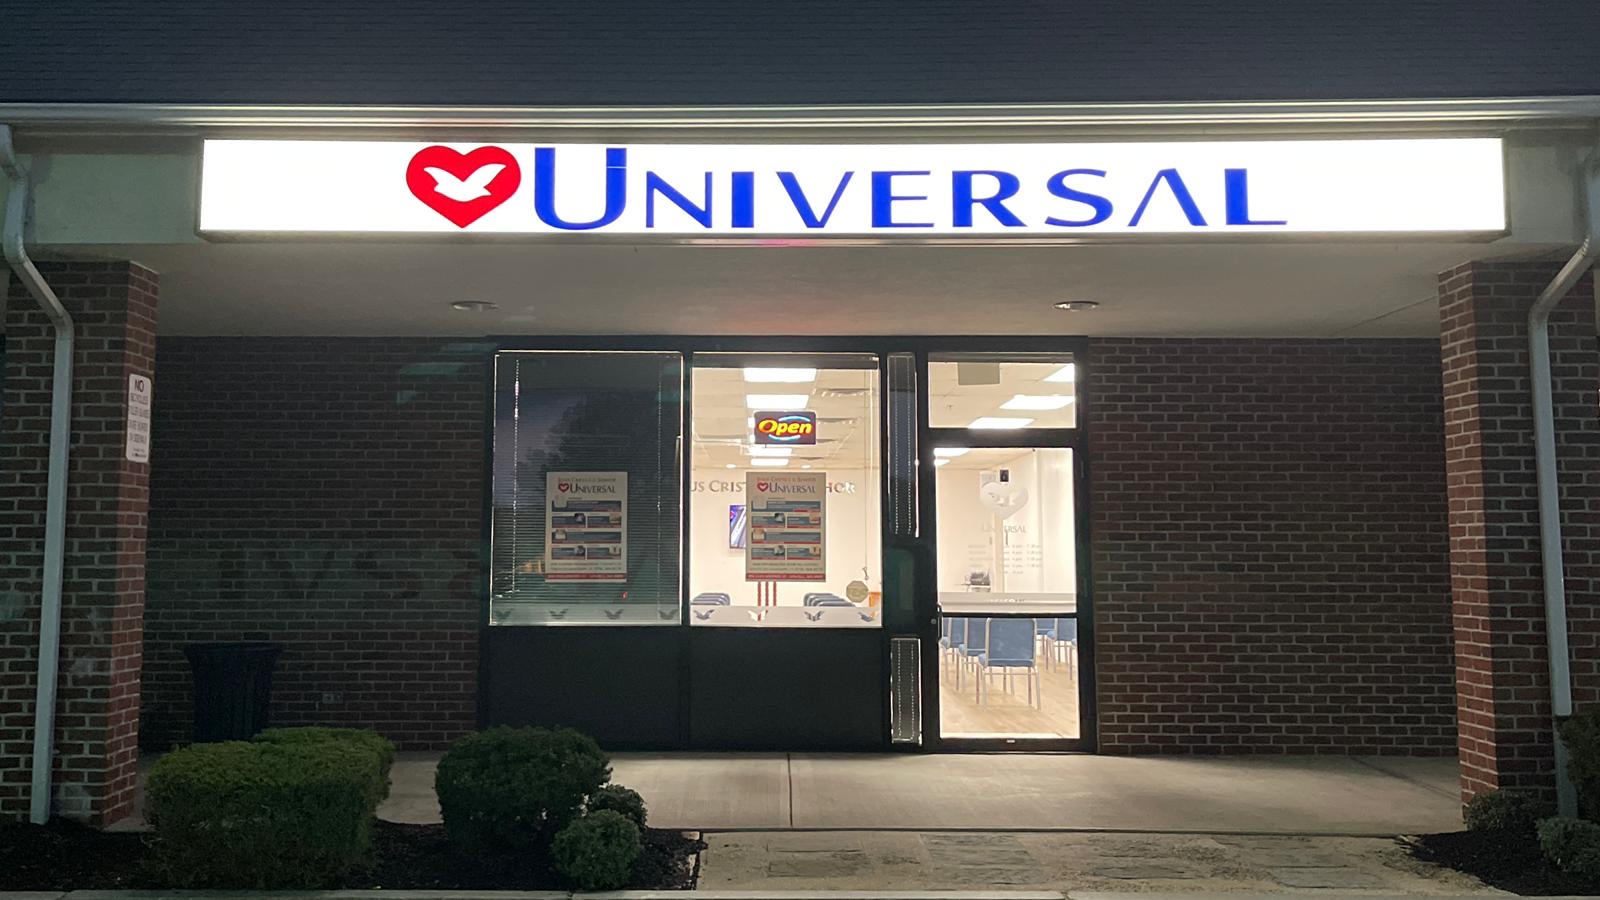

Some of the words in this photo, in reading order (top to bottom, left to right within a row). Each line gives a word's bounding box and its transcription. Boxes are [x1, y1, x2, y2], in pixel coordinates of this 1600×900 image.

[534, 147, 1288, 230] UNIVERSAL
[135, 380, 144, 392] NO
[758, 419, 812, 436] Open
[570, 483, 616, 493] UNIVERSAL
[769, 482, 816, 494] UNIVERSAL
